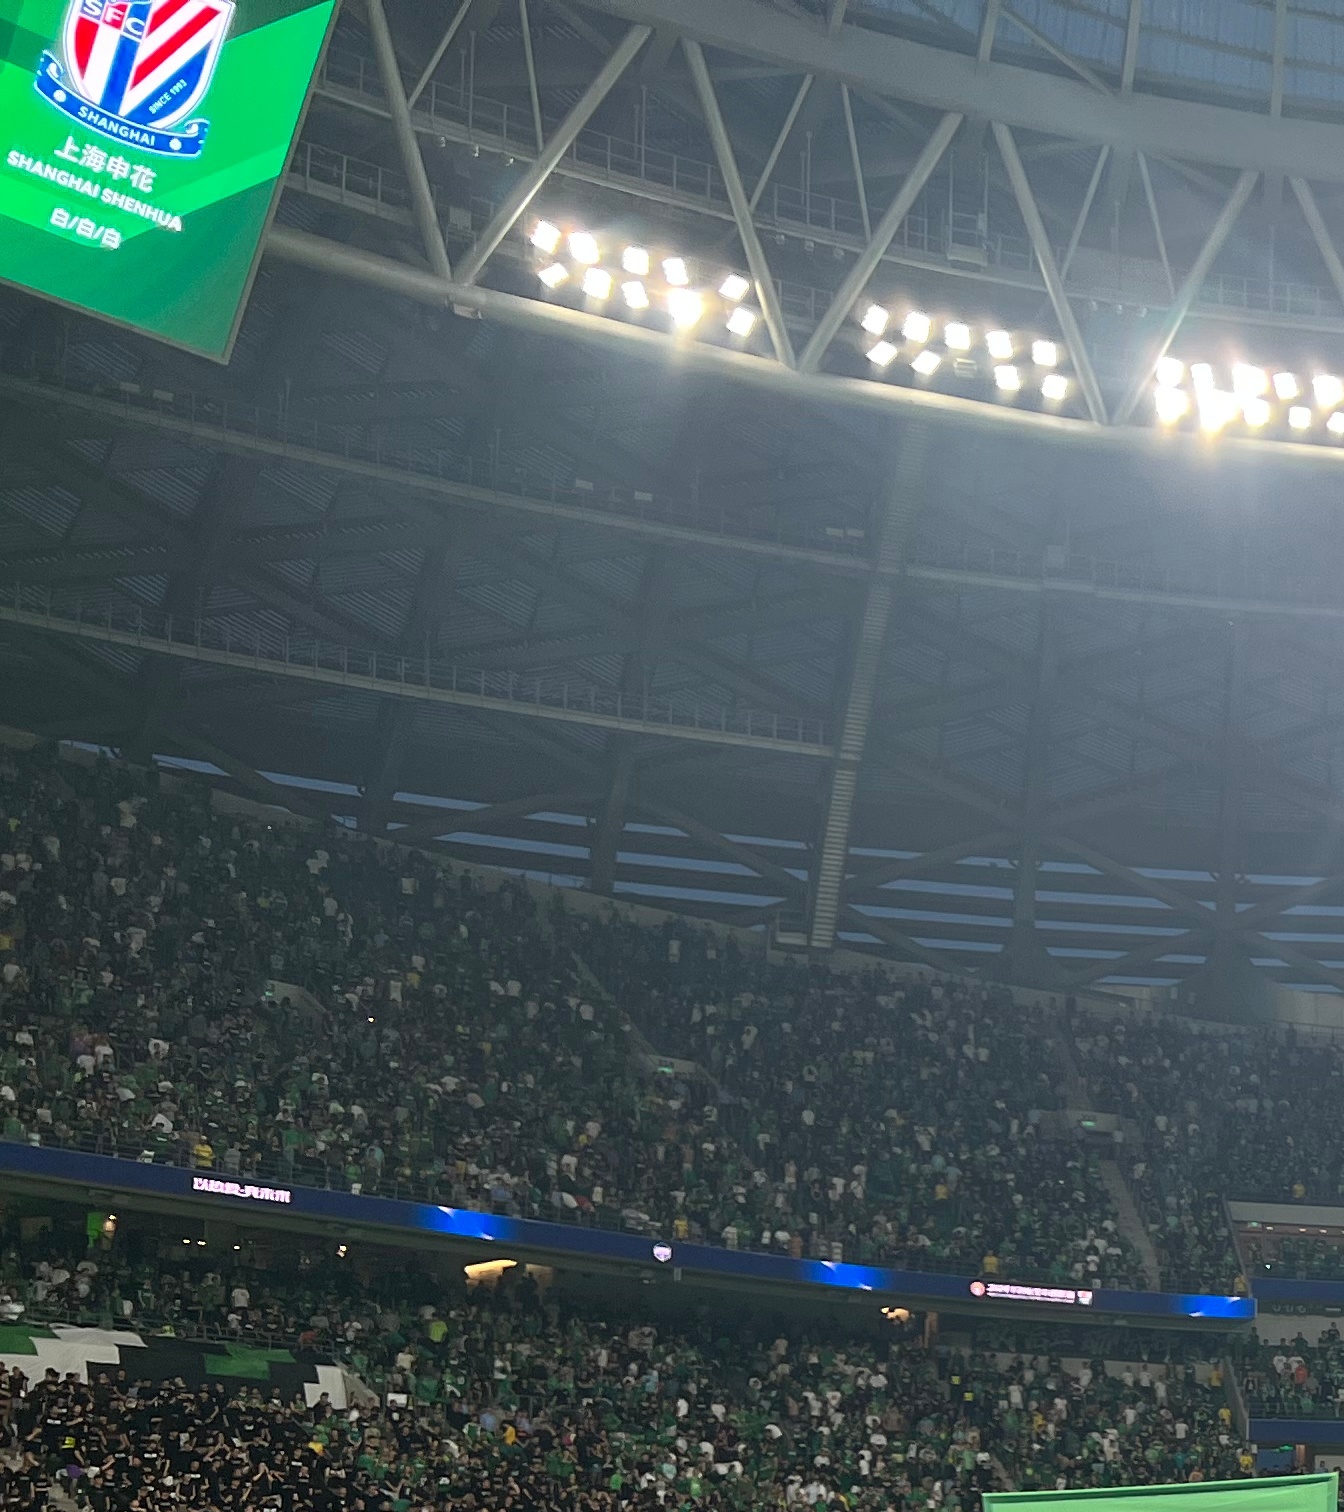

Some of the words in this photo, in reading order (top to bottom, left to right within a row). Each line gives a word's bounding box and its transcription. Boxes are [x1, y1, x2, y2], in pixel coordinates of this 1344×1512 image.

[83, 0, 145, 36] SFC
[78, 106, 155, 146] SHANGHAI
[54, 135, 157, 193] 上海申花
[7, 150, 100, 198] SHANGHAI
[100, 188, 182, 231] SHENHUA
